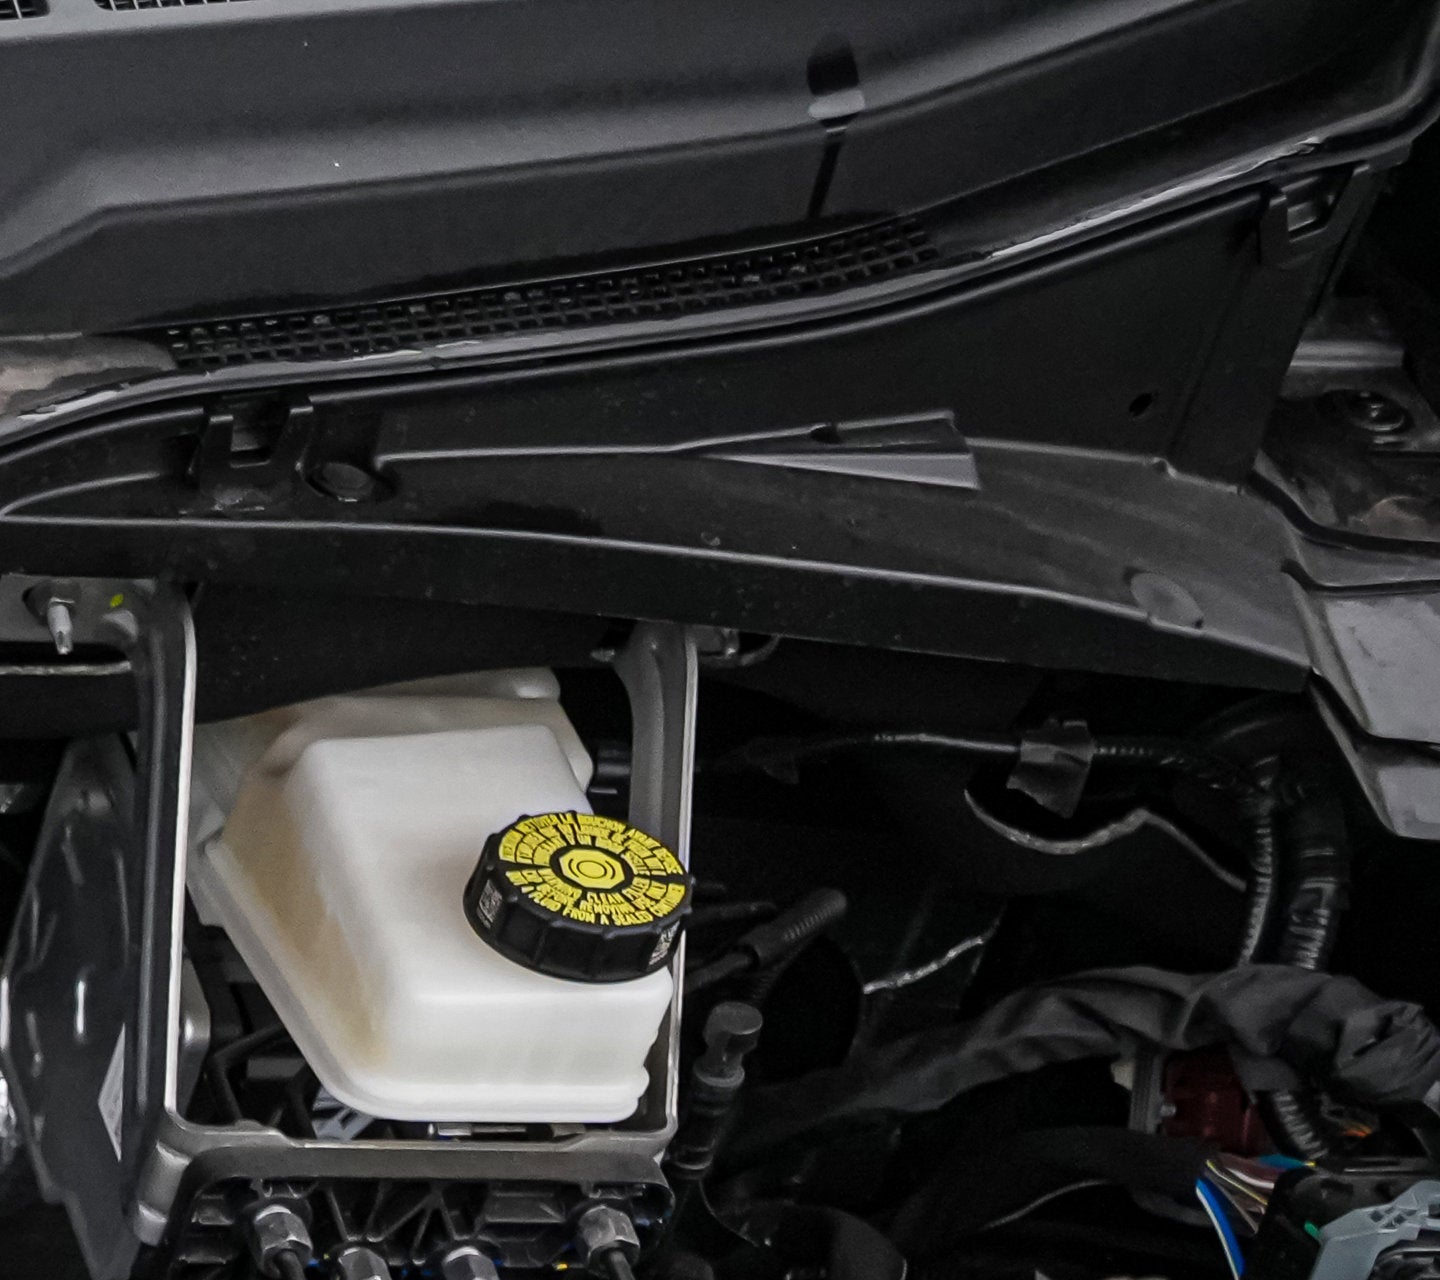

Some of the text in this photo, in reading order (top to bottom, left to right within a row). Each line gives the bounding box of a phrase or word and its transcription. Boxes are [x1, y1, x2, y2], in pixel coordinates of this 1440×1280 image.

[586, 891, 625, 905] CLEAN
[530, 892, 562, 912] FLUID
[562, 907, 596, 925] FROM
[600, 912, 610, 926] A
[612, 910, 653, 927] SEALED
[579, 899, 635, 916] REMOVING
